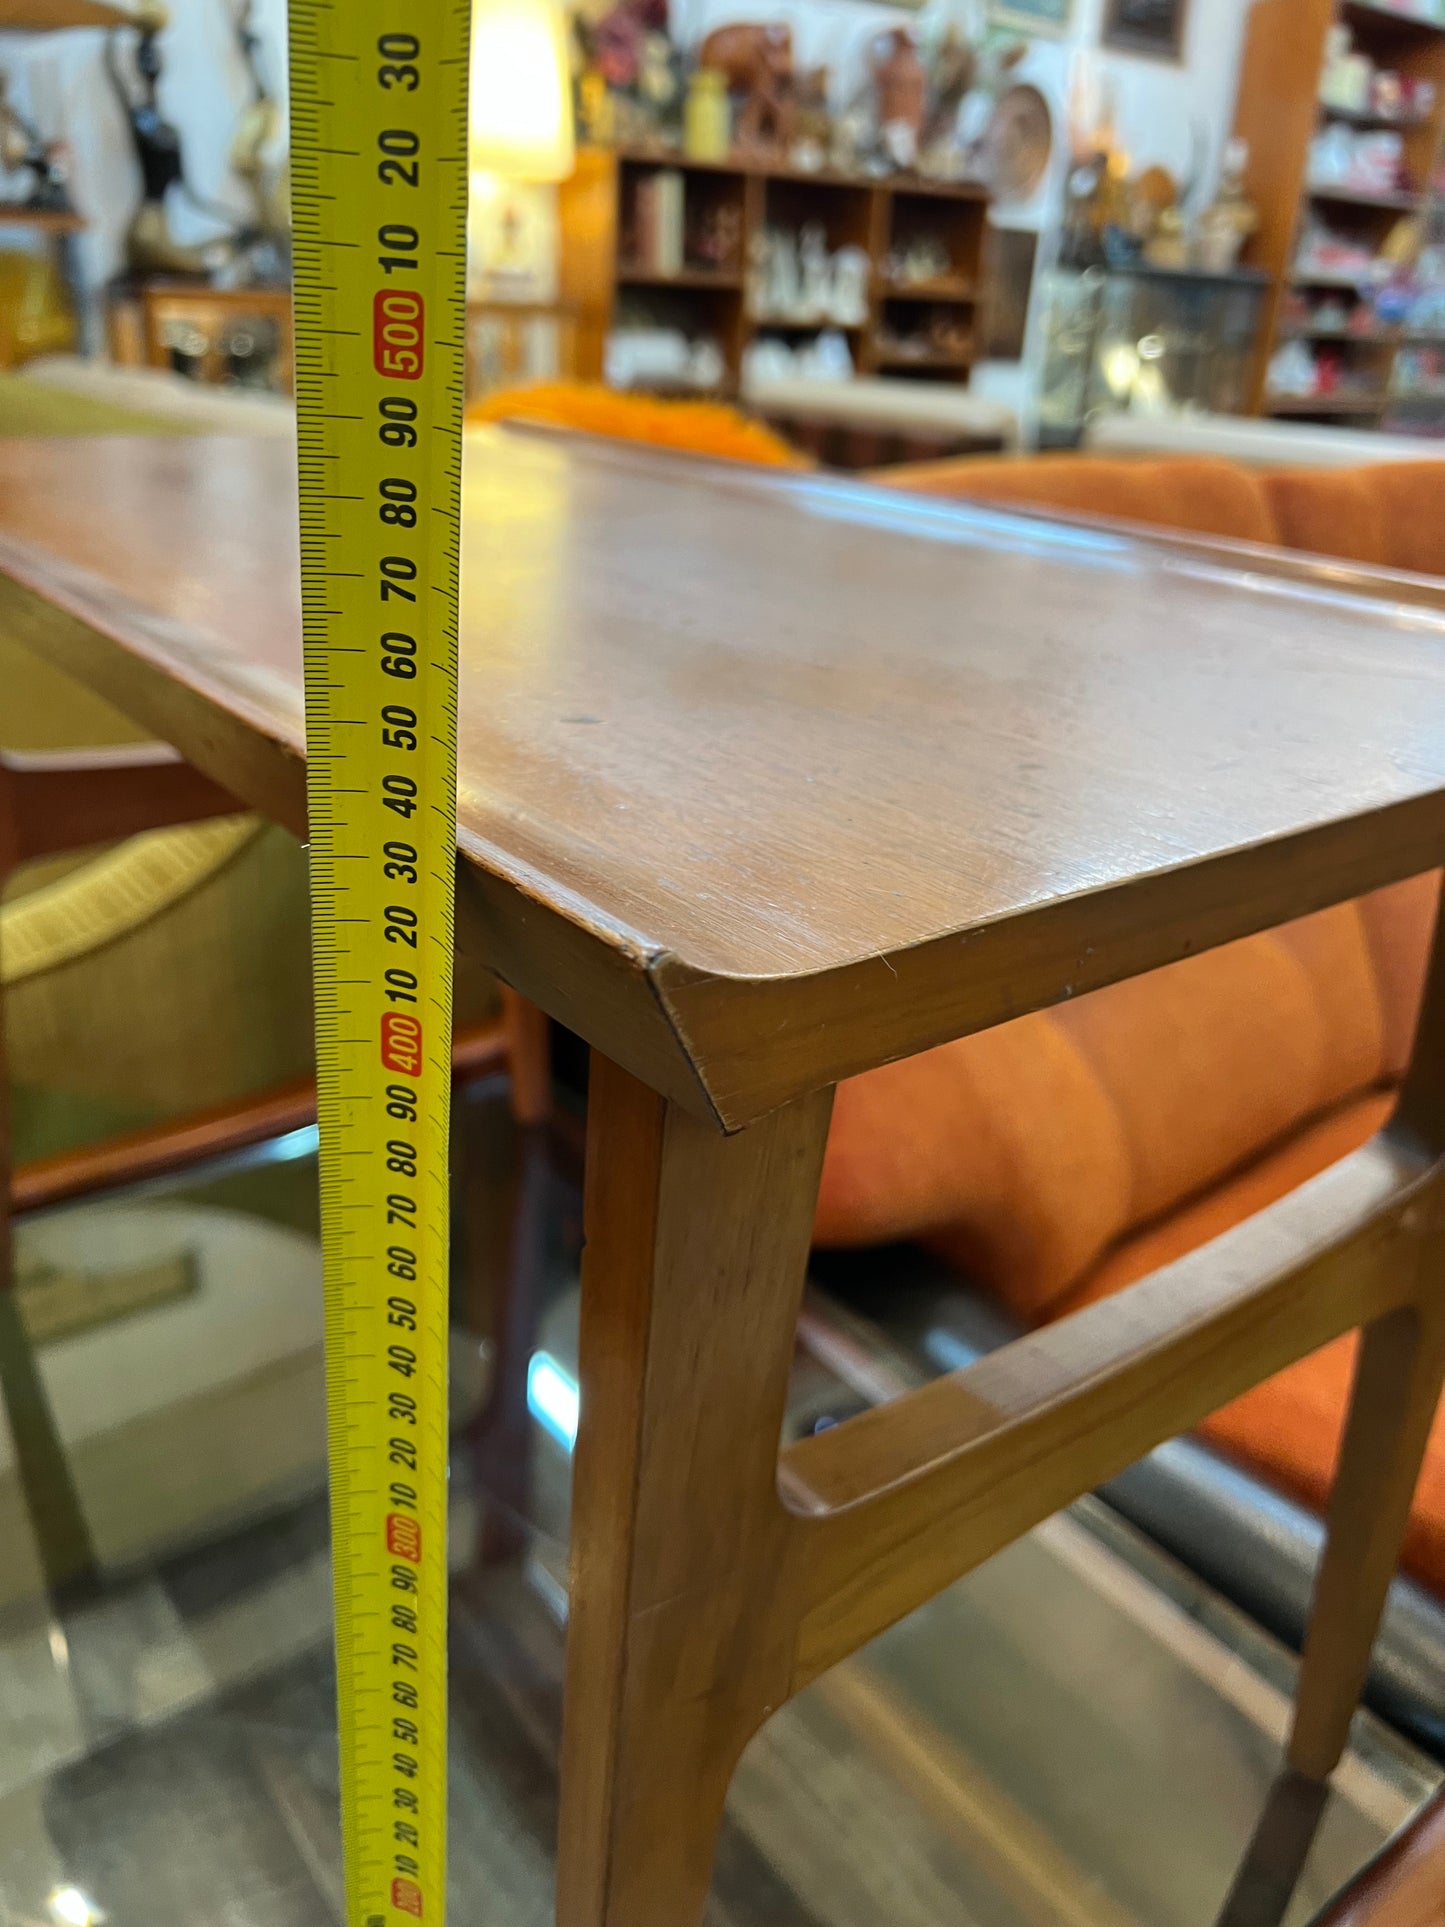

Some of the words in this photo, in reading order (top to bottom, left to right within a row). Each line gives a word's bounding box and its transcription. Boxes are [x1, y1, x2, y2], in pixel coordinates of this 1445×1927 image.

[378, 33, 420, 92] 30
[378, 129, 420, 187] 20
[378, 224, 419, 275] 10
[382, 296, 419, 373] 500
[378, 396, 418, 448] 90
[378, 477, 417, 529] 80
[379, 556, 417, 603] 70
[380, 632, 417, 680] 60
[381, 704, 417, 751] 50
[382, 774, 418, 819] 40
[383, 841, 418, 884] 30
[384, 905, 418, 949] 20
[384, 968, 418, 1003] 10
[388, 1017, 418, 1071] 400
[386, 1084, 418, 1123] 90
[386, 1140, 417, 1178] 80
[387, 1194, 417, 1229] 70
[387, 1246, 417, 1281] 60
[387, 1296, 417, 1331] 50
[388, 1345, 417, 1378] 40
[389, 1392, 417, 1425] 30
[389, 1437, 417, 1471] 20
[390, 1483, 417, 1510] 10
[391, 1516, 419, 1559] 300
[391, 1565, 418, 1595] 90
[391, 1604, 417, 1634] 80
[392, 1643, 418, 1672] 70
[392, 1681, 418, 1709] 60
[393, 1717, 418, 1745] 50
[393, 1753, 418, 1778] 40
[394, 1788, 418, 1814] 30
[394, 1821, 418, 1848] 20
